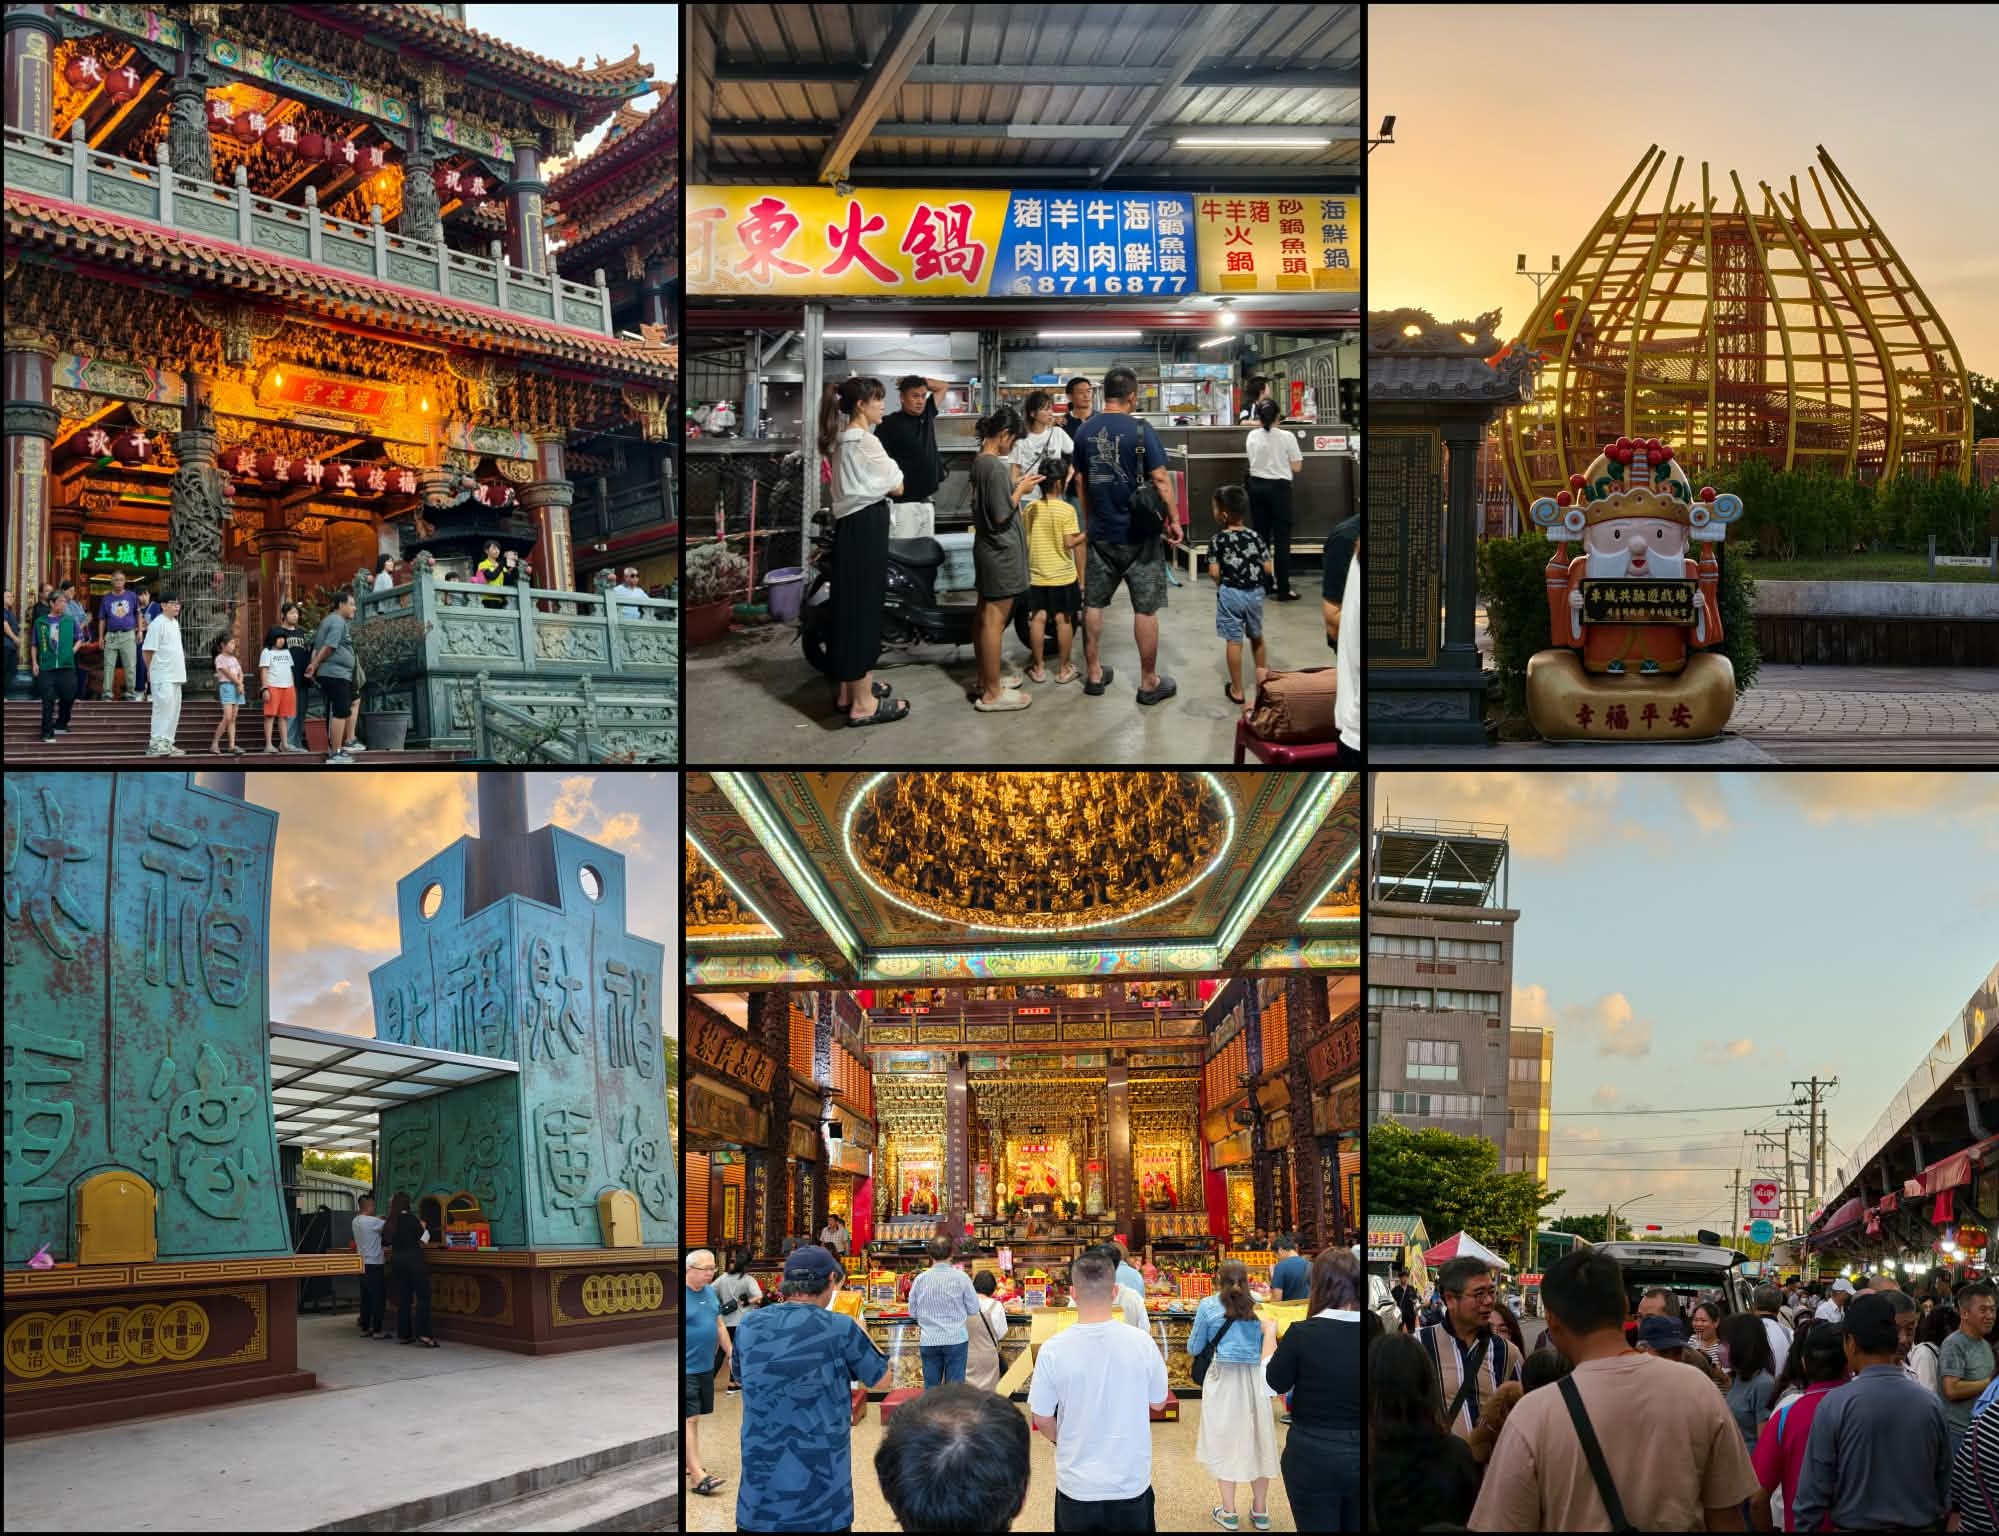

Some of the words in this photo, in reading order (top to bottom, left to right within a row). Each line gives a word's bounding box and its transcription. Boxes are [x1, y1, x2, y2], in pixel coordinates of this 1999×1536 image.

[1201, 199, 1270, 224] 牛羊豬
[1320, 199, 1351, 270] 海鮮鍋
[1157, 200, 1187, 273] 砂鍋魚頭
[1225, 225, 1254, 272] 火鍋
[1278, 199, 1309, 274] 砂鍋魚頭
[1037, 276, 1187, 293] 8716877
[1575, 703, 1694, 731] 幸福平安
